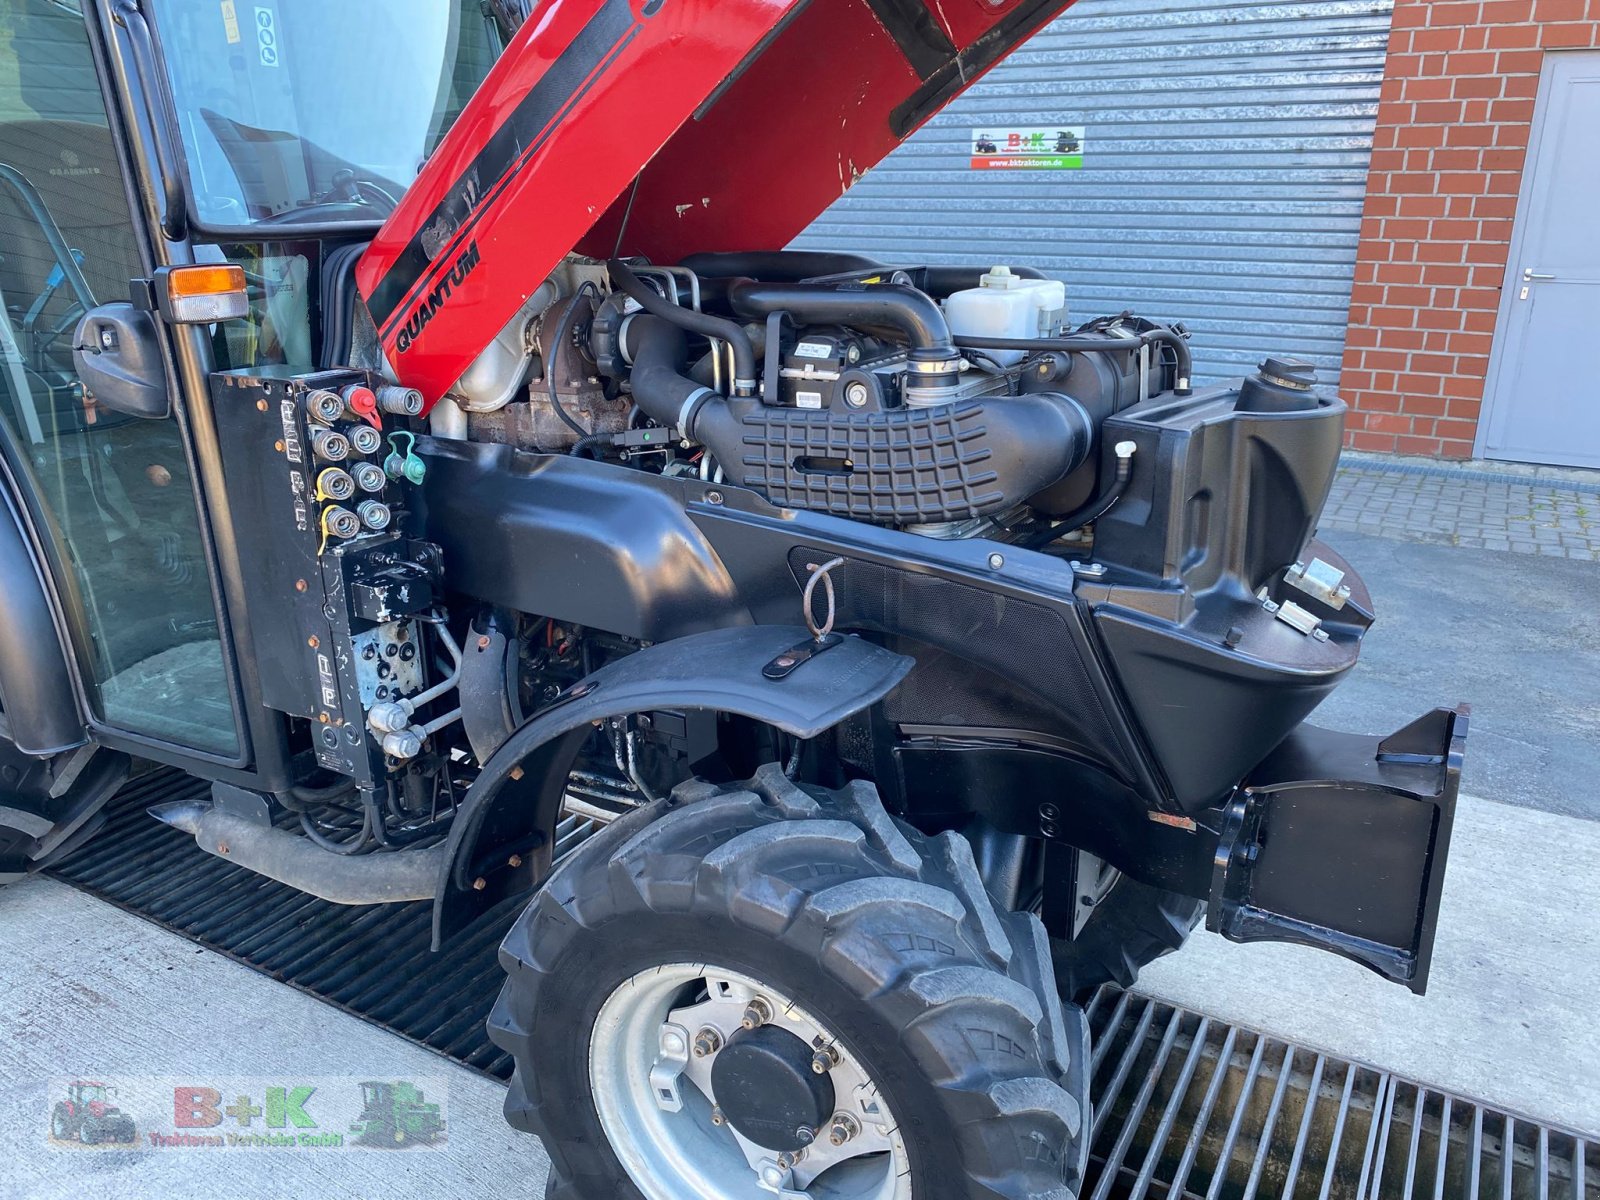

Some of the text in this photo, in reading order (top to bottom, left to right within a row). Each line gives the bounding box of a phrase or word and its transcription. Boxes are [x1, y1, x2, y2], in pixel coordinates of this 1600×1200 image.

[1007, 133, 1045, 147] B+K
[989, 159, 1063, 168] www.bktraktoren.de
[395, 238, 481, 353] QUANTUM
